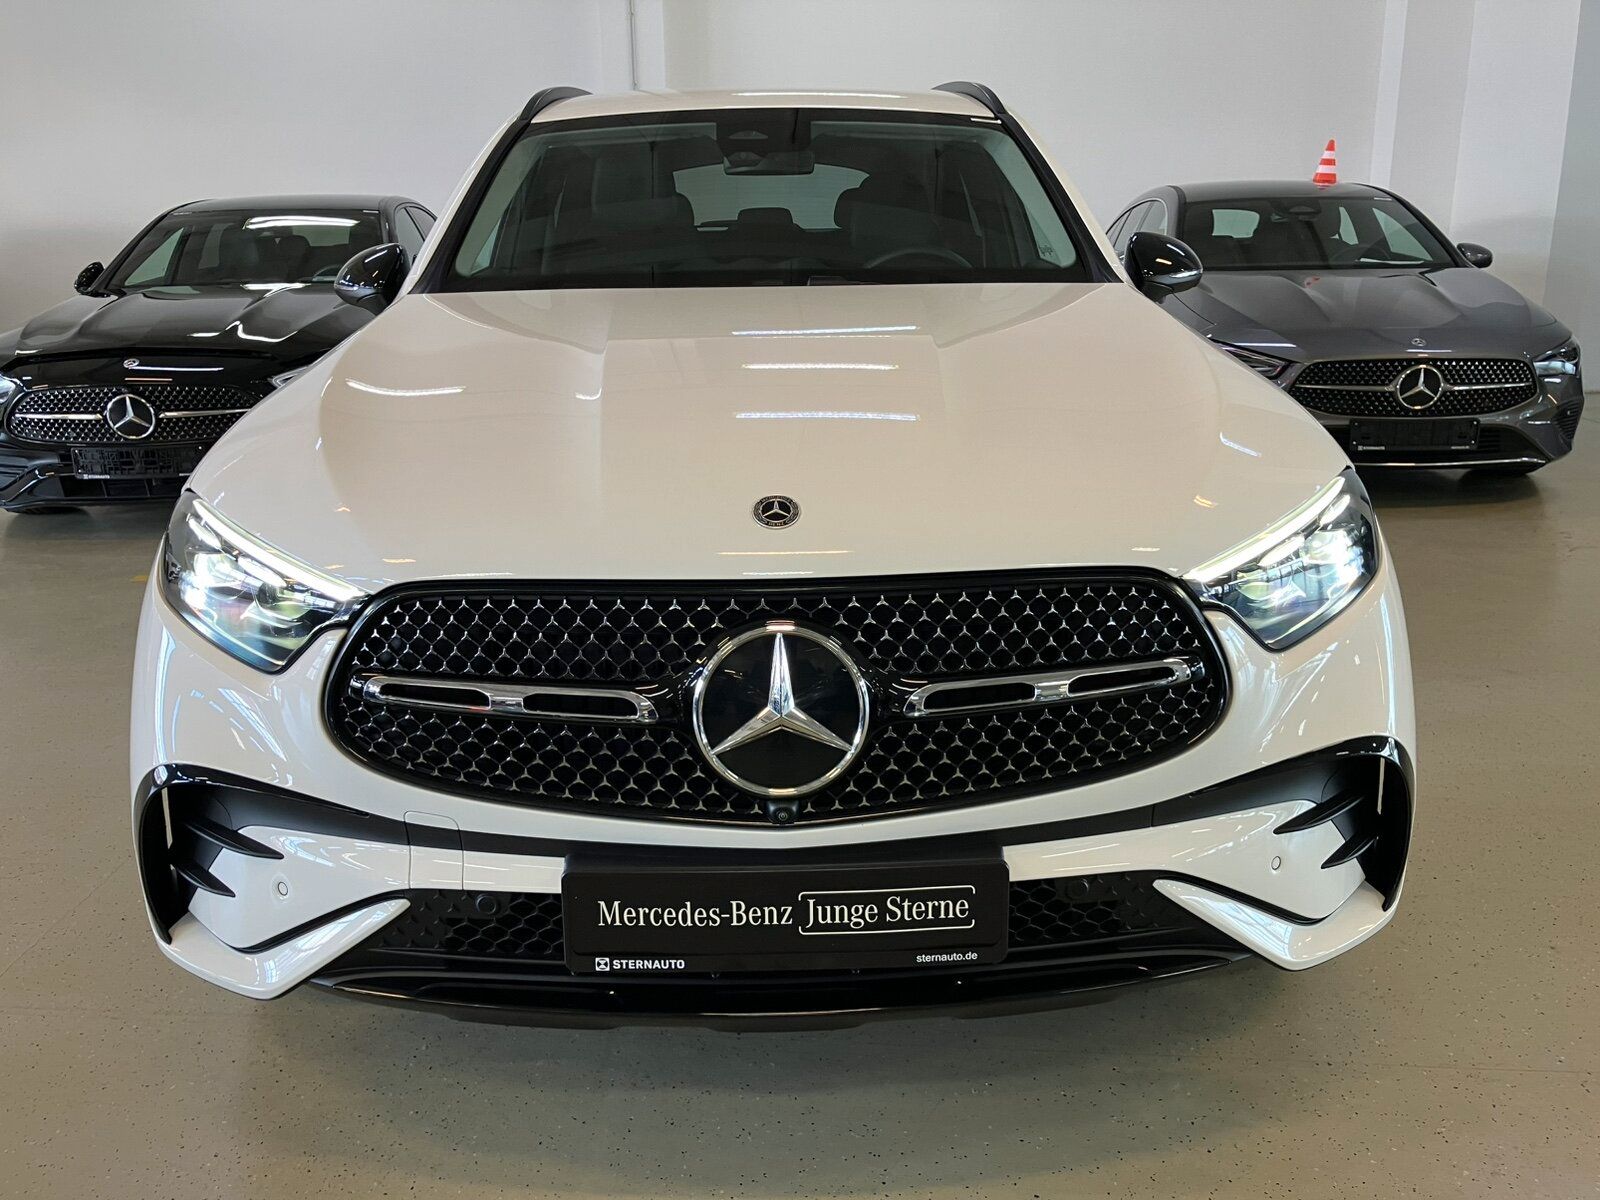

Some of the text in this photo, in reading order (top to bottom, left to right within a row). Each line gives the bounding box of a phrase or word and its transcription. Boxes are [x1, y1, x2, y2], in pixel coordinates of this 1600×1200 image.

[597, 895, 969, 929] Mercedes-Benz Junge Sterne
[916, 951, 978, 963] sternauto.de
[612, 959, 685, 969] STERNAUTO
